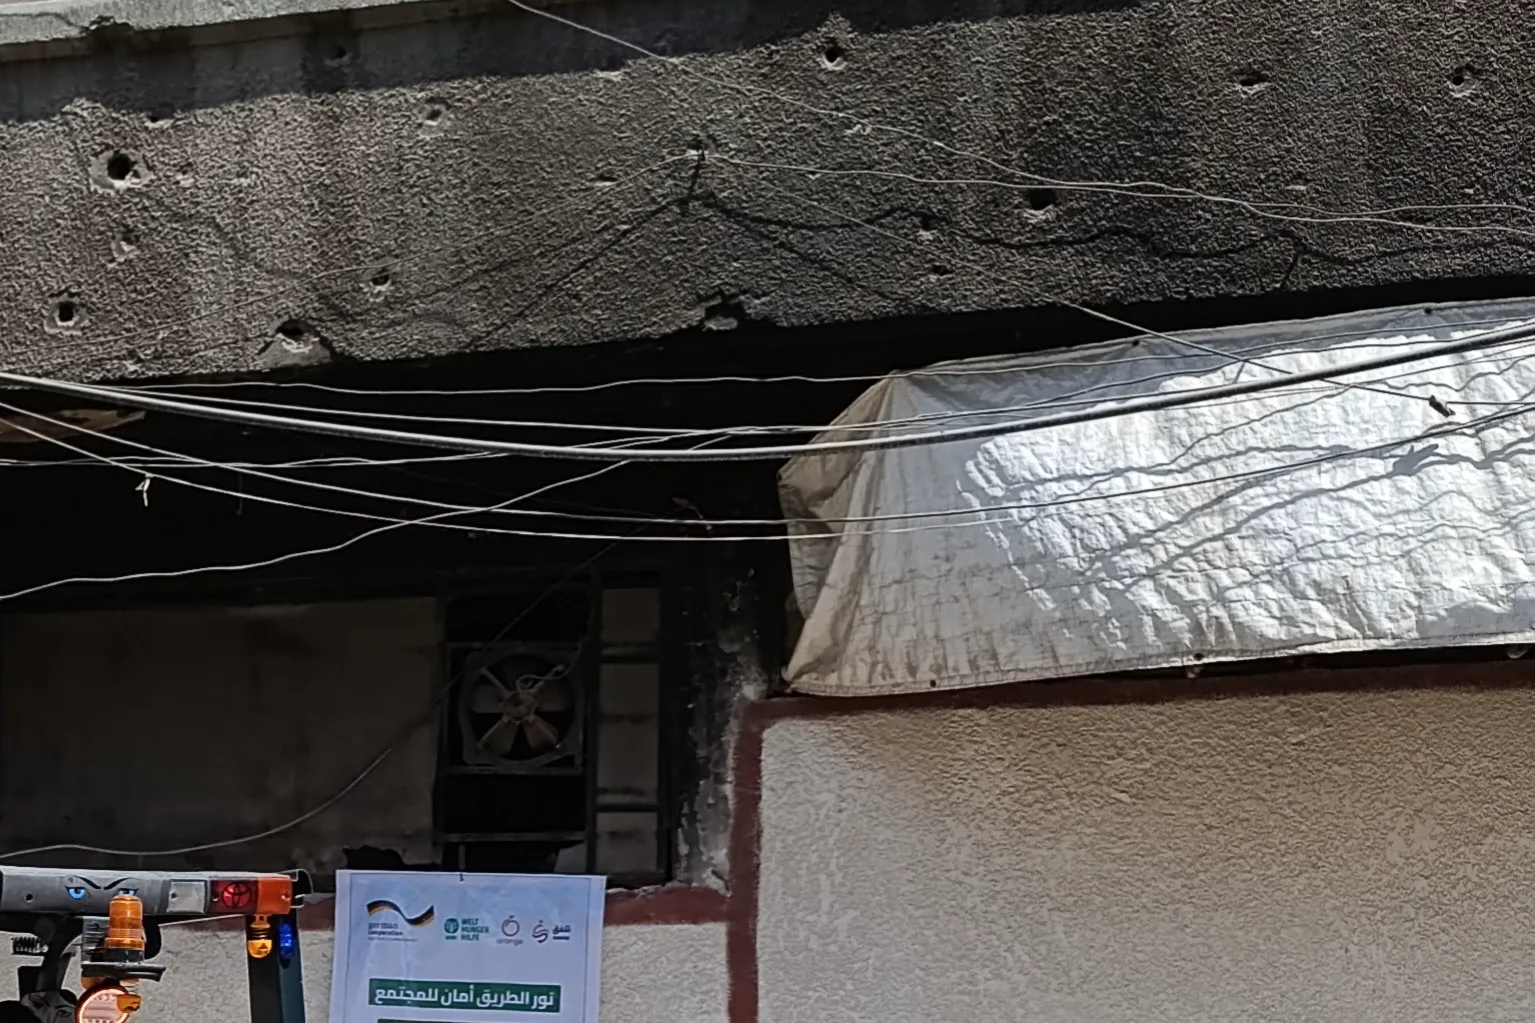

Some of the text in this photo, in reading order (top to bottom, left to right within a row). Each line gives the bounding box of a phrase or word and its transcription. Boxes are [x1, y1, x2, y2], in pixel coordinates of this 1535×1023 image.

[374, 984, 554, 1009] نور الطريق أمان للمجتمع
